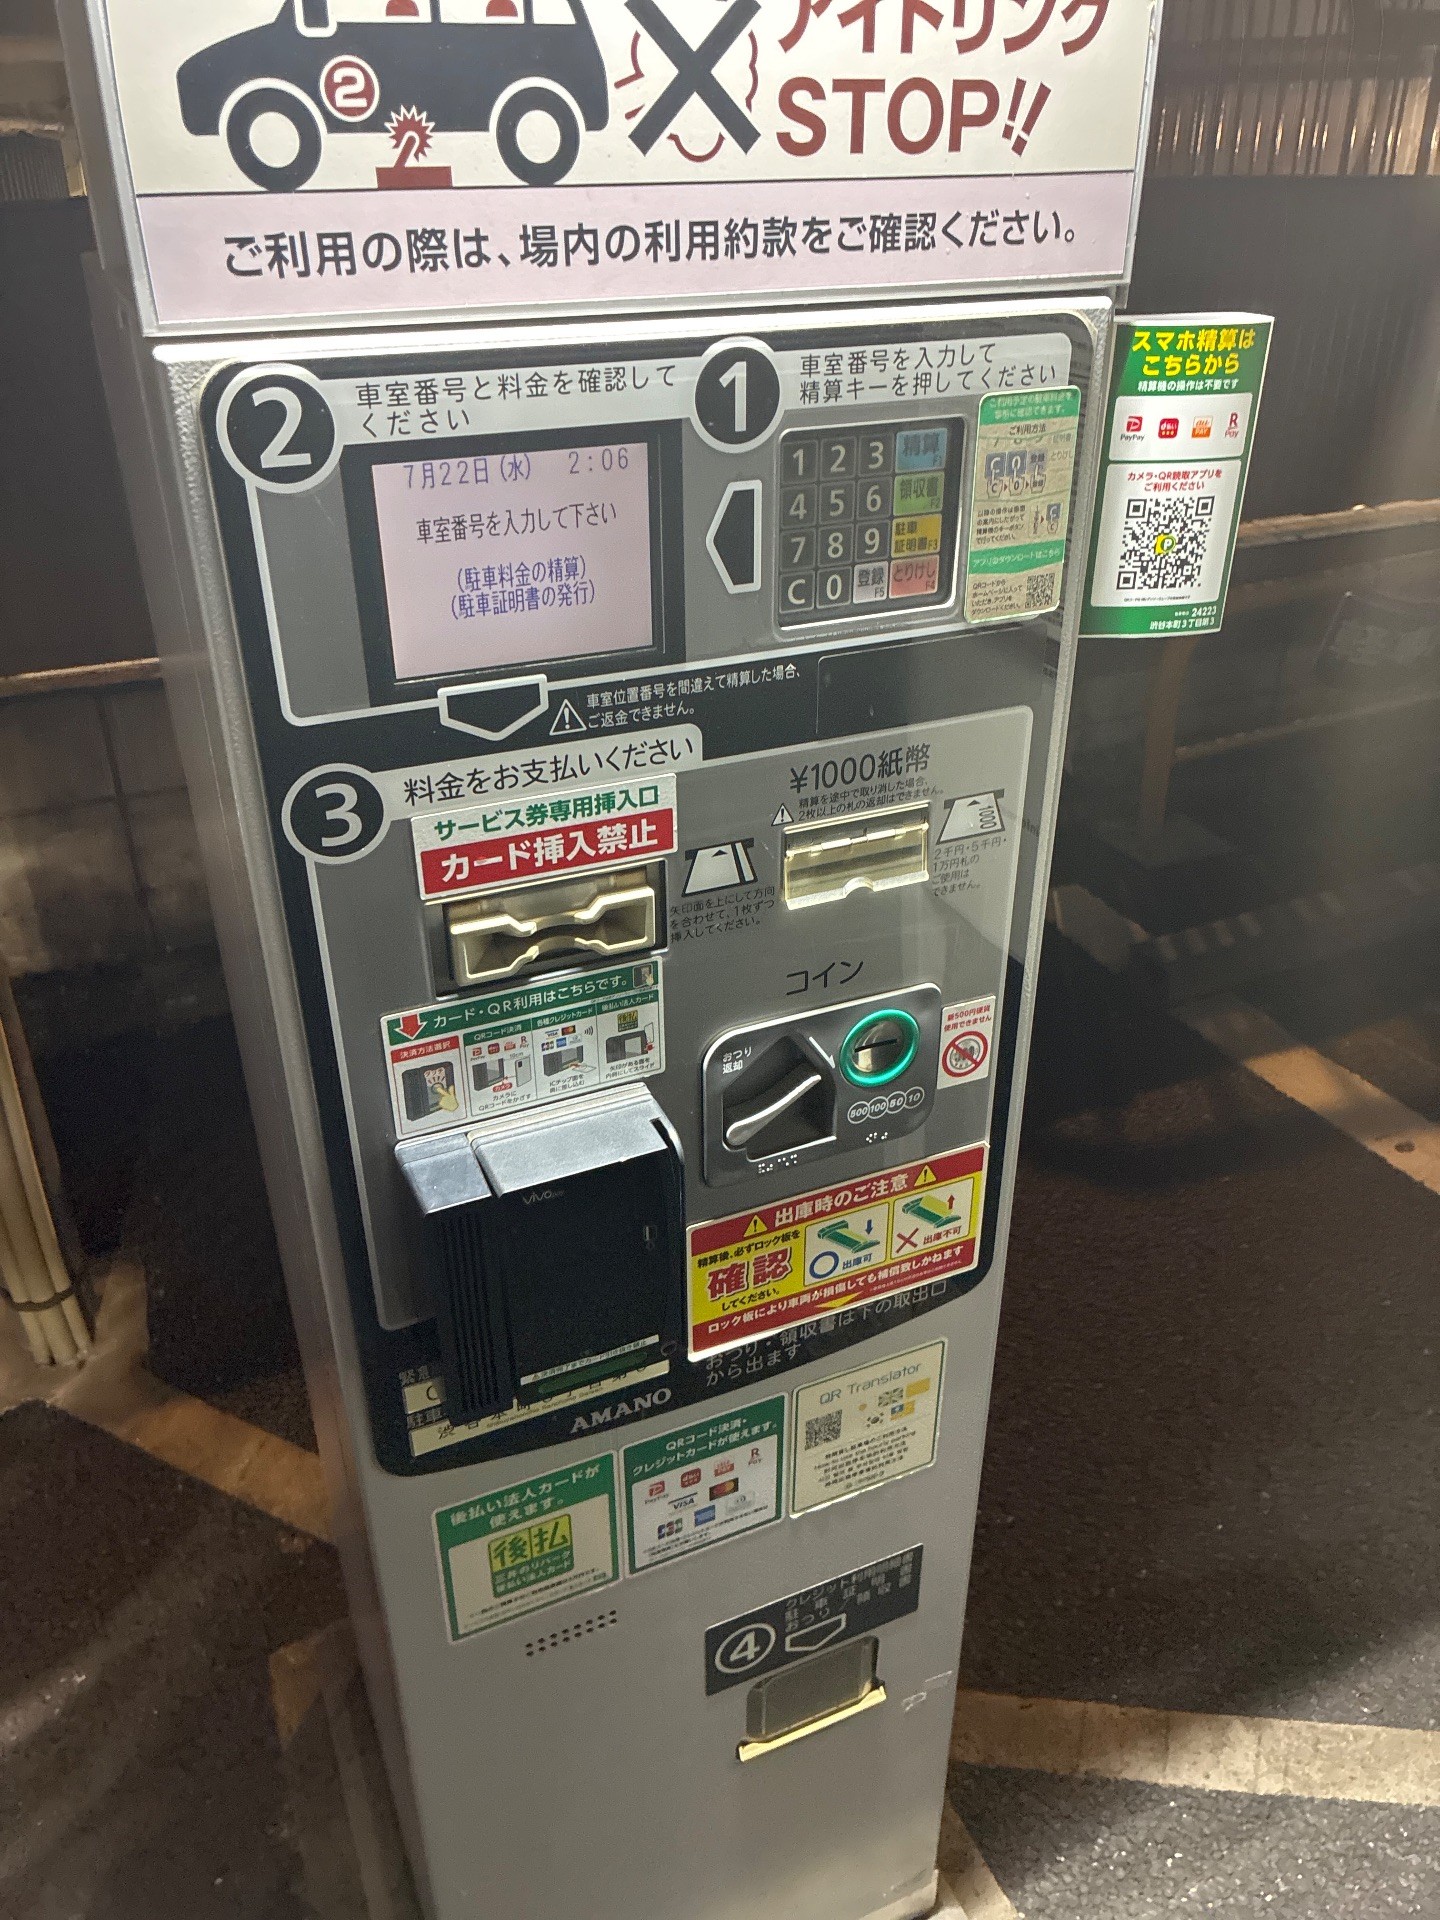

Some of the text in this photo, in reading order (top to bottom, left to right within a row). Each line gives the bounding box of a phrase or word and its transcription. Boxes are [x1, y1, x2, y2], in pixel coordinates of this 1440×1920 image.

[776, 76, 1052, 157] STOP!!
[223, 209, 1076, 278] ご利用の際は、場内の利用約款をご確認ください。
[1132, 328, 1256, 352] スマホ精算は
[799, 342, 997, 379] 車室番号を入力して
[1142, 353, 1240, 376] こちらから
[355, 364, 677, 410] 車室番号と料金を確認して
[718, 361, 748, 432] 1
[799, 364, 1056, 406] 精算キーを押してください
[1137, 378, 1239, 393] 精算機の操作は不要です
[252, 386, 312, 469] 2
[361, 408, 470, 439] ください
[1120, 433, 1145, 442] PayPay
[792, 448, 804, 476] 1
[830, 444, 846, 474] 2
[868, 441, 884, 470] 3
[789, 476, 939, 520] 4 5 6 領収書
[1144, 480, 1205, 492] ご利用ください
[416, 501, 618, 544] 車室番号を入力して下さい
[790, 536, 806, 564] 7
[827, 532, 844, 559] 8
[864, 527, 880, 555] 9
[457, 554, 586, 592] (駐車料金の精算)
[787, 559, 936, 605] C 0 登録 とりけし
[874, 584, 885, 598] F5
[451, 579, 595, 620] (駐車証明書の発行)
[1191, 605, 1218, 617] 24223
[586, 663, 801, 709] 車室位置番号を間違えて精算した場合、
[587, 699, 696, 730] ご返金できません。
[403, 736, 694, 807] 料金をお支払いください
[789, 742, 931, 794] ¥1000紙幣
[797, 776, 928, 809] 精算を途中で取り消した場合、
[797, 785, 945, 822] 2枚以上の札の返却はできません。
[313, 781, 364, 848] 3
[433, 784, 660, 841] サービス券専用挿入口
[440, 822, 660, 884] カード挿入禁止
[670, 886, 775, 917] 矢印面を上にして方向
[670, 899, 775, 930] を合わせて、1枚ずつ
[670, 917, 761, 943] 挿入してください。
[785, 960, 864, 996] コイン
[433, 974, 627, 1029] カード・QR利用はこちらです。
[943, 1015, 992, 1033] 使用できません
[722, 1046, 752, 1063] おつり
[722, 1059, 744, 1075] 返却
[774, 1172, 908, 1229] 出庫時のご注意
[922, 1225, 962, 1246] 出庫不可
[705, 1247, 793, 1301] 確認
[842, 1252, 873, 1271] 出庫可
[721, 1288, 781, 1312] してください。
[706, 1343, 802, 1381] から出ます
[820, 1362, 922, 1405] QR Translator
[569, 1387, 673, 1434] AMANO
[489, 1495, 564, 1530] 使えます。
[673, 1497, 695, 1510] VISA
[493, 1521, 569, 1569] 後払
[729, 1630, 761, 1662] 4
